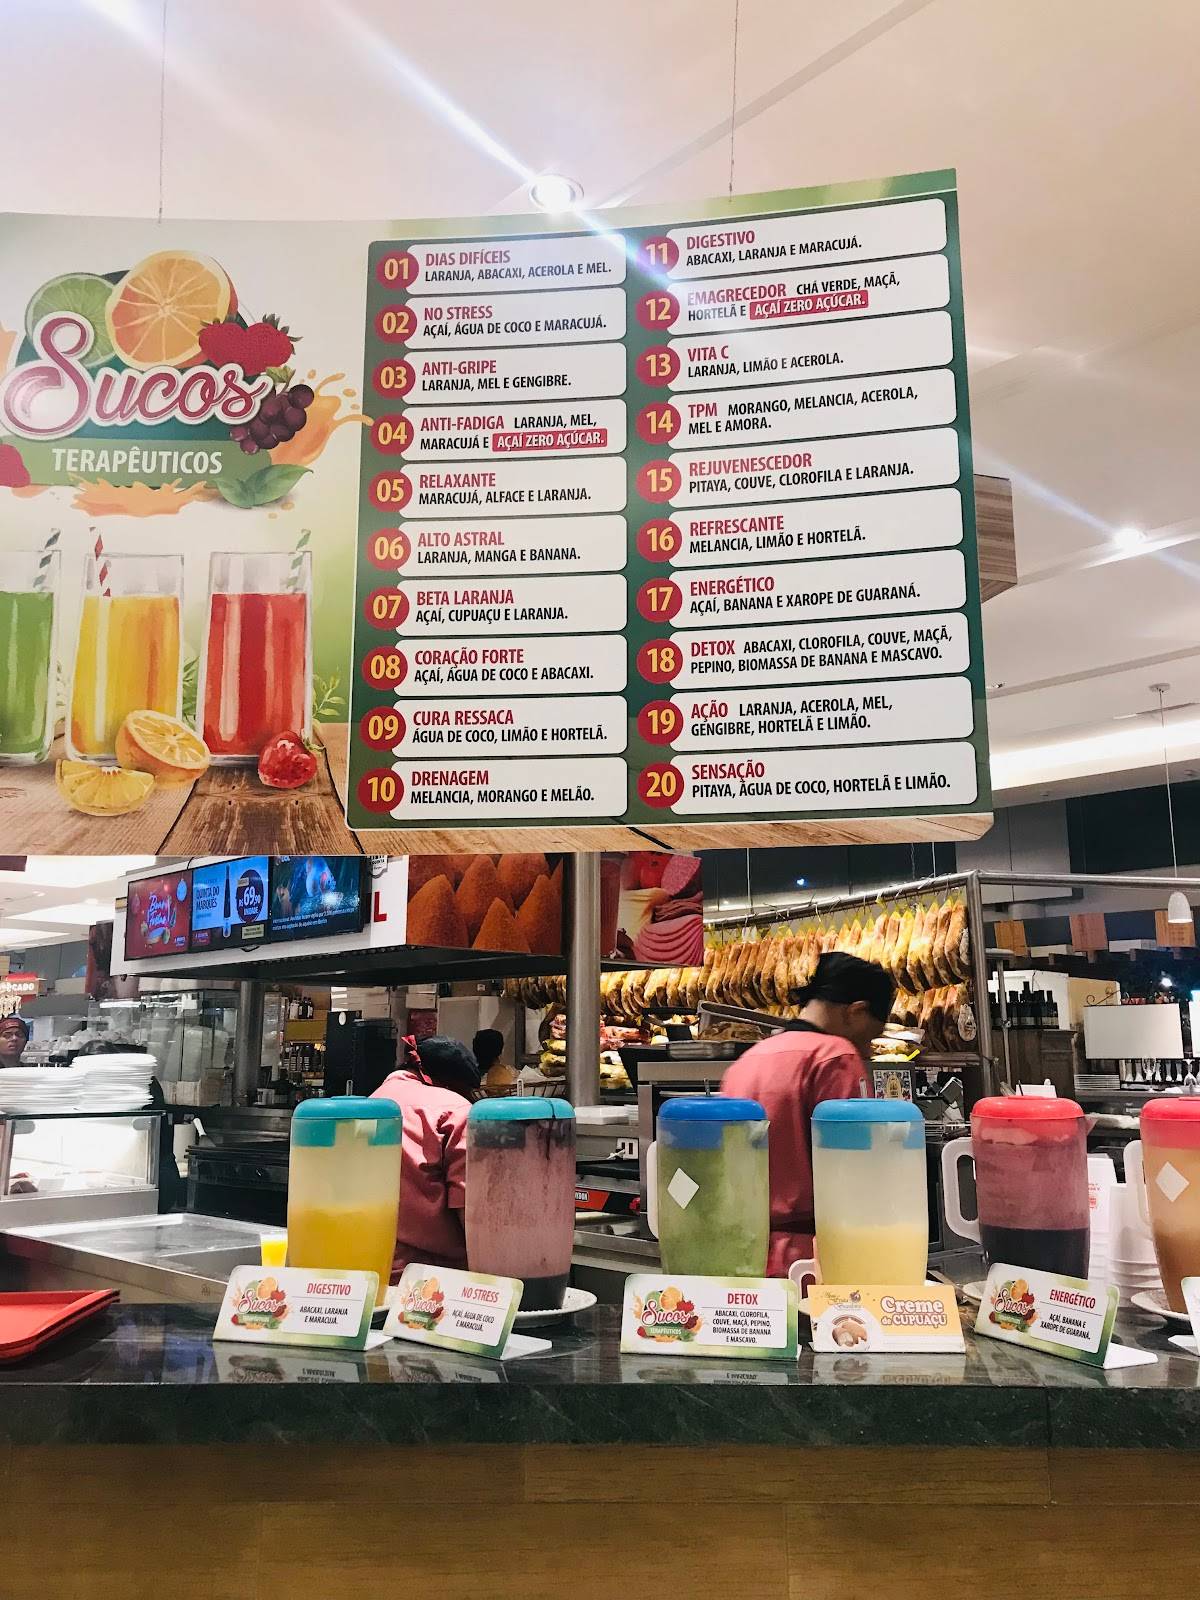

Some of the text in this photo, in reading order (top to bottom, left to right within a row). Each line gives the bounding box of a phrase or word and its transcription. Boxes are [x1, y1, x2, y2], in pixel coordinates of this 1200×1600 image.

[686, 230, 755, 250] DIGESTIVO
[425, 248, 511, 266] DIAS DIFÍCEIS
[645, 243, 669, 265] 11
[384, 258, 409, 280] 01
[424, 262, 612, 283] LARANJA, ABACAXI, ACEROLA E MEL.
[687, 273, 900, 306] EMAGRECEDOR CHÁ VERDE, MAÇÃ,
[424, 306, 493, 321] NO STRESS
[645, 298, 672, 321] 12
[688, 291, 866, 322] HORTELÃ E AÇAÍ ZERO AÇÚCAR.
[382, 311, 409, 334] 02
[687, 345, 729, 362] VITA C
[4, 315, 268, 435] Sucos
[422, 360, 497, 376] ANTI-GRIPE
[645, 354, 672, 377] 13
[380, 366, 407, 389] 03
[422, 375, 572, 393] LARANJA, MEL E GENGIBRE.
[688, 387, 918, 419] TPM MORANGO, MELANCIA, ACEROLA,
[378, 422, 408, 445] 04
[420, 414, 597, 432] ANTI-FADIGA LARANJA, MEL,
[646, 410, 674, 434] 14
[688, 417, 772, 435] MEL E AMORA.
[420, 430, 605, 452] MARACUJÁ E AÇAÍ ZERO AÇÚCAR.
[52, 446, 223, 475] TERAPÊUTICOS
[689, 453, 812, 477] REJUVENESCEDOR
[376, 478, 405, 502] 05
[419, 472, 496, 489] RELAXANTE
[646, 468, 673, 492] 15
[689, 463, 914, 495] PITAYA, COUVE, CLOROFILA E LARANJA.
[690, 515, 784, 537] REFRESCANTE
[375, 536, 404, 560] 06
[417, 531, 505, 547] ALTO ASTRAL
[646, 527, 675, 551] 16
[690, 575, 775, 596] ENERGÉTICO
[372, 595, 402, 619] 07
[417, 589, 514, 606] BETA LARANJA
[646, 586, 674, 611] 17
[691, 626, 952, 657] DETOX ABACAXI, CLOROFILA, COUVE, MAÇÃ,
[370, 655, 401, 679] 08
[414, 647, 524, 668] CORAÇÃO FORTE
[647, 648, 675, 673] 18
[691, 647, 942, 676] PEPINO, BIOMASSA DE BANANA E MASCAVO.
[413, 709, 514, 726] CURA RESSACA
[691, 696, 893, 722] AÇÃO LARANJA, ACEROLA, MEL,
[368, 715, 399, 740] 09
[647, 709, 675, 735] 19
[411, 770, 489, 786] DRENAGEM
[691, 760, 765, 783] SENSAÇÃO
[367, 776, 396, 802] 10
[646, 771, 677, 797] 20
[410, 786, 595, 806] MELANCIA, MORANGO E MELÃO.
[307, 1283, 351, 1295] DIGESTIVO
[406, 1288, 439, 1312] Sucos
[462, 1287, 500, 1303] NO STRESS
[727, 1293, 758, 1305] DETOX
[1050, 1289, 1096, 1309] ENERGÉTICO
[238, 1289, 281, 1313] Sucos
[642, 1300, 690, 1325] Sucos
[881, 1296, 944, 1313] Creme
[995, 1288, 1030, 1314] Sucos
[881, 1314, 947, 1328] de CUPUAÇU
[1040, 1321, 1059, 1331] XAROPE
[1062, 1316, 1082, 1327] BANANA
[731, 1336, 757, 1344] MASCAVO.
